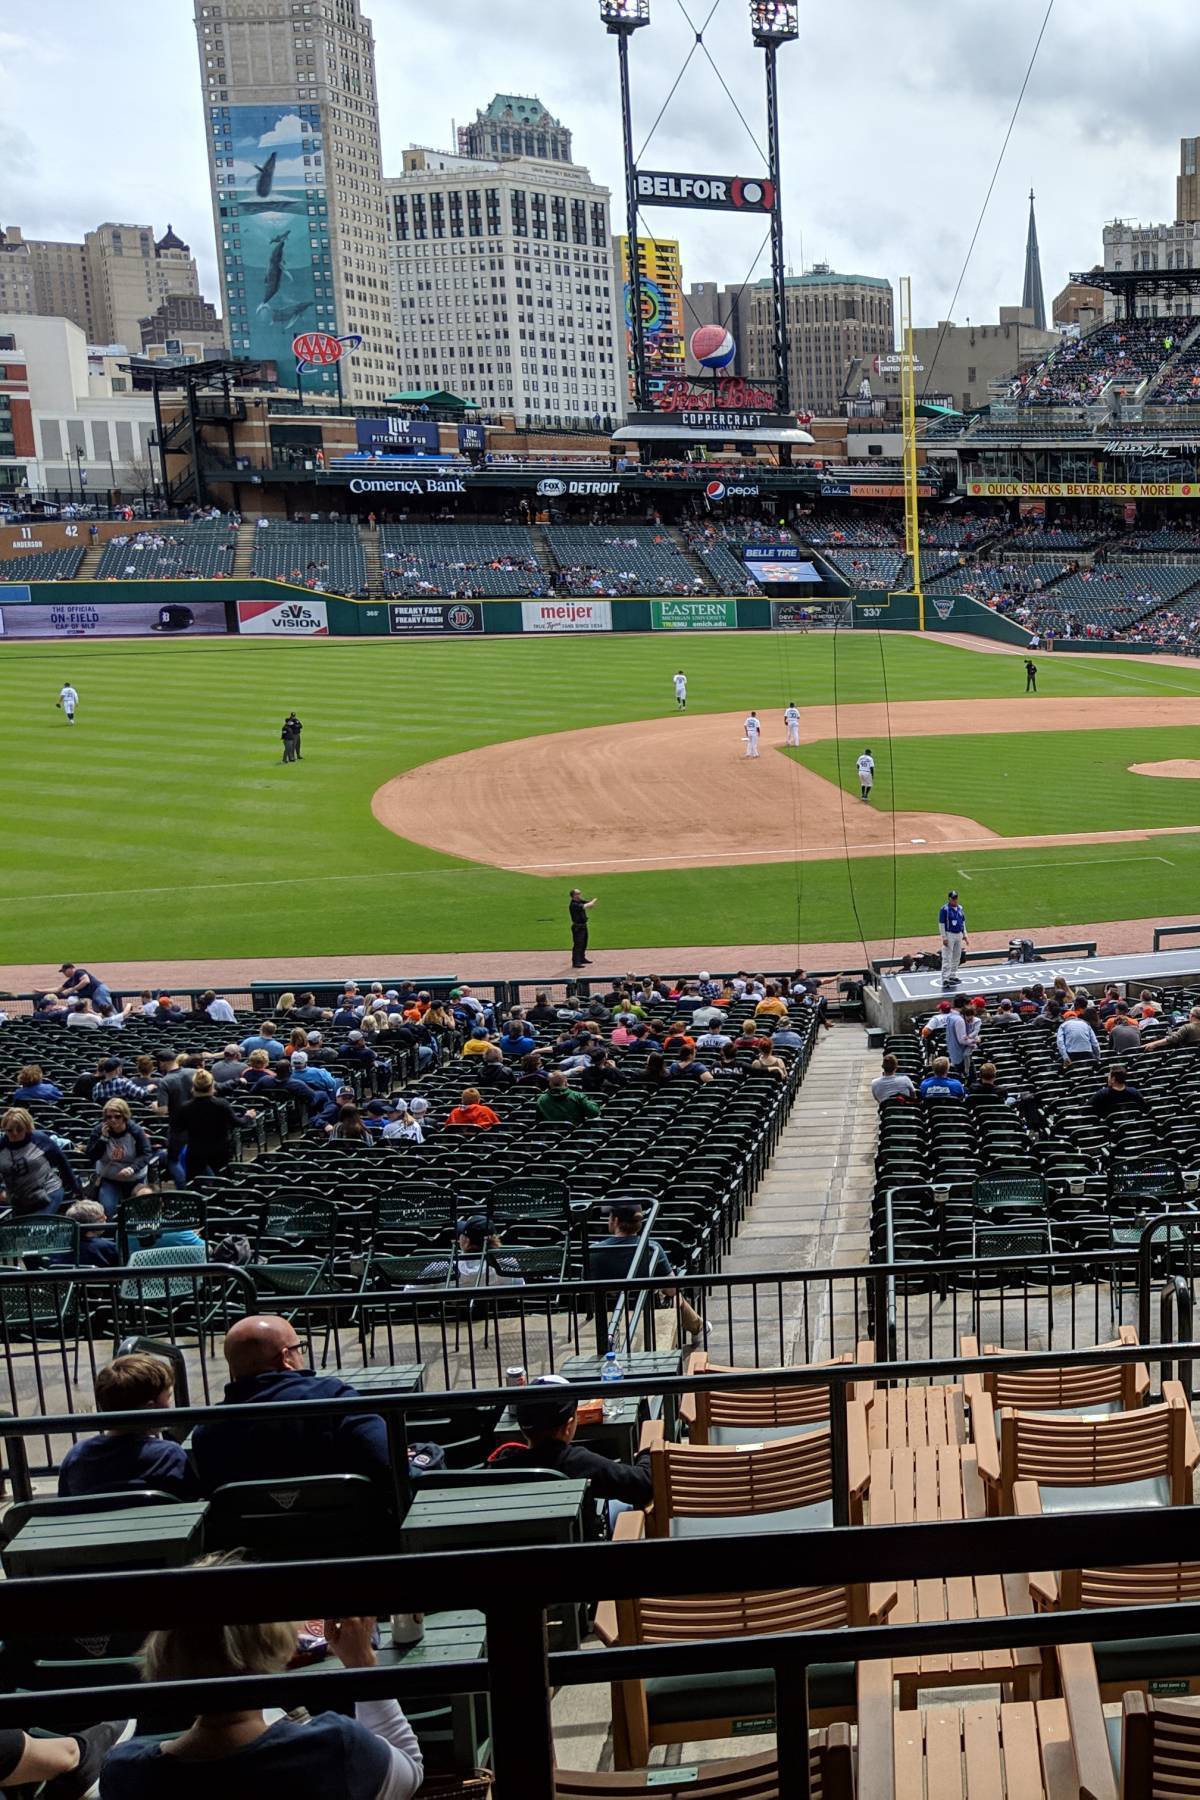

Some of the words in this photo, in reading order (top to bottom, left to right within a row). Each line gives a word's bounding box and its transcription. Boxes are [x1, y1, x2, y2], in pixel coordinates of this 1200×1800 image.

[637, 175, 727, 201] BELFOR
[387, 416, 410, 435] Lite
[682, 413, 761, 426] COPPERCRAFT
[371, 435, 410, 443] PITCHER'S
[426, 479, 467, 493] Bank
[543, 482, 560, 490] FOX
[568, 482, 620, 494] DETROIT
[727, 485, 759, 498] pepsi
[987, 484, 1019, 496] QUICK
[1021, 484, 1064, 496] SNACKS,
[1067, 484, 1127, 496] BEVERAGES
[1129, 484, 1137, 495] &
[1140, 484, 1175, 496] MORE!
[21, 527, 32, 539] 11
[65, 525, 79, 537] 42
[12, 541, 43, 549] ANDERSON
[746, 549, 775, 558] BELLE
[776, 548, 797, 557] TIRE
[394, 607, 423, 615] FREAKY
[541, 603, 593, 622] meijer
[661, 602, 727, 615] EASTERN
[51, 613, 99, 623] ON-FIELD
[272, 619, 321, 628] VISION
[395, 616, 420, 624] FREAKY
